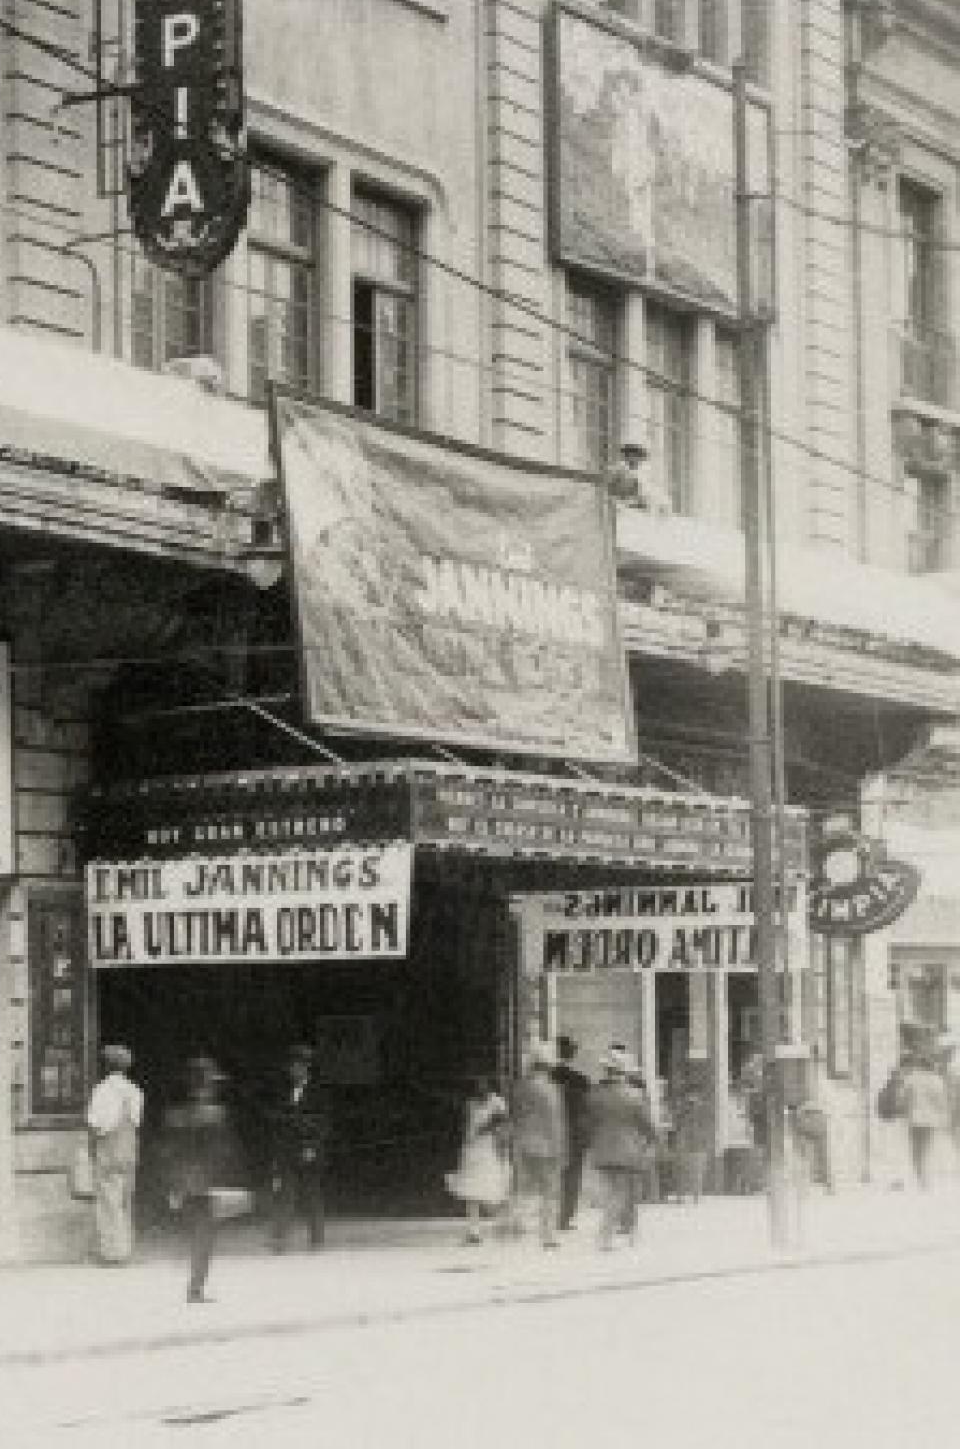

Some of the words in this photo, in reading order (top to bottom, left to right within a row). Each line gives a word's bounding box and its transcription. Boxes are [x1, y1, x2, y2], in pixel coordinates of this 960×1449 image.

[94, 866, 166, 901] EMIL
[185, 854, 381, 896] JANNINGS
[93, 911, 134, 960] LA
[143, 907, 267, 957] ULTIMA
[276, 902, 399, 954] ORDEN
